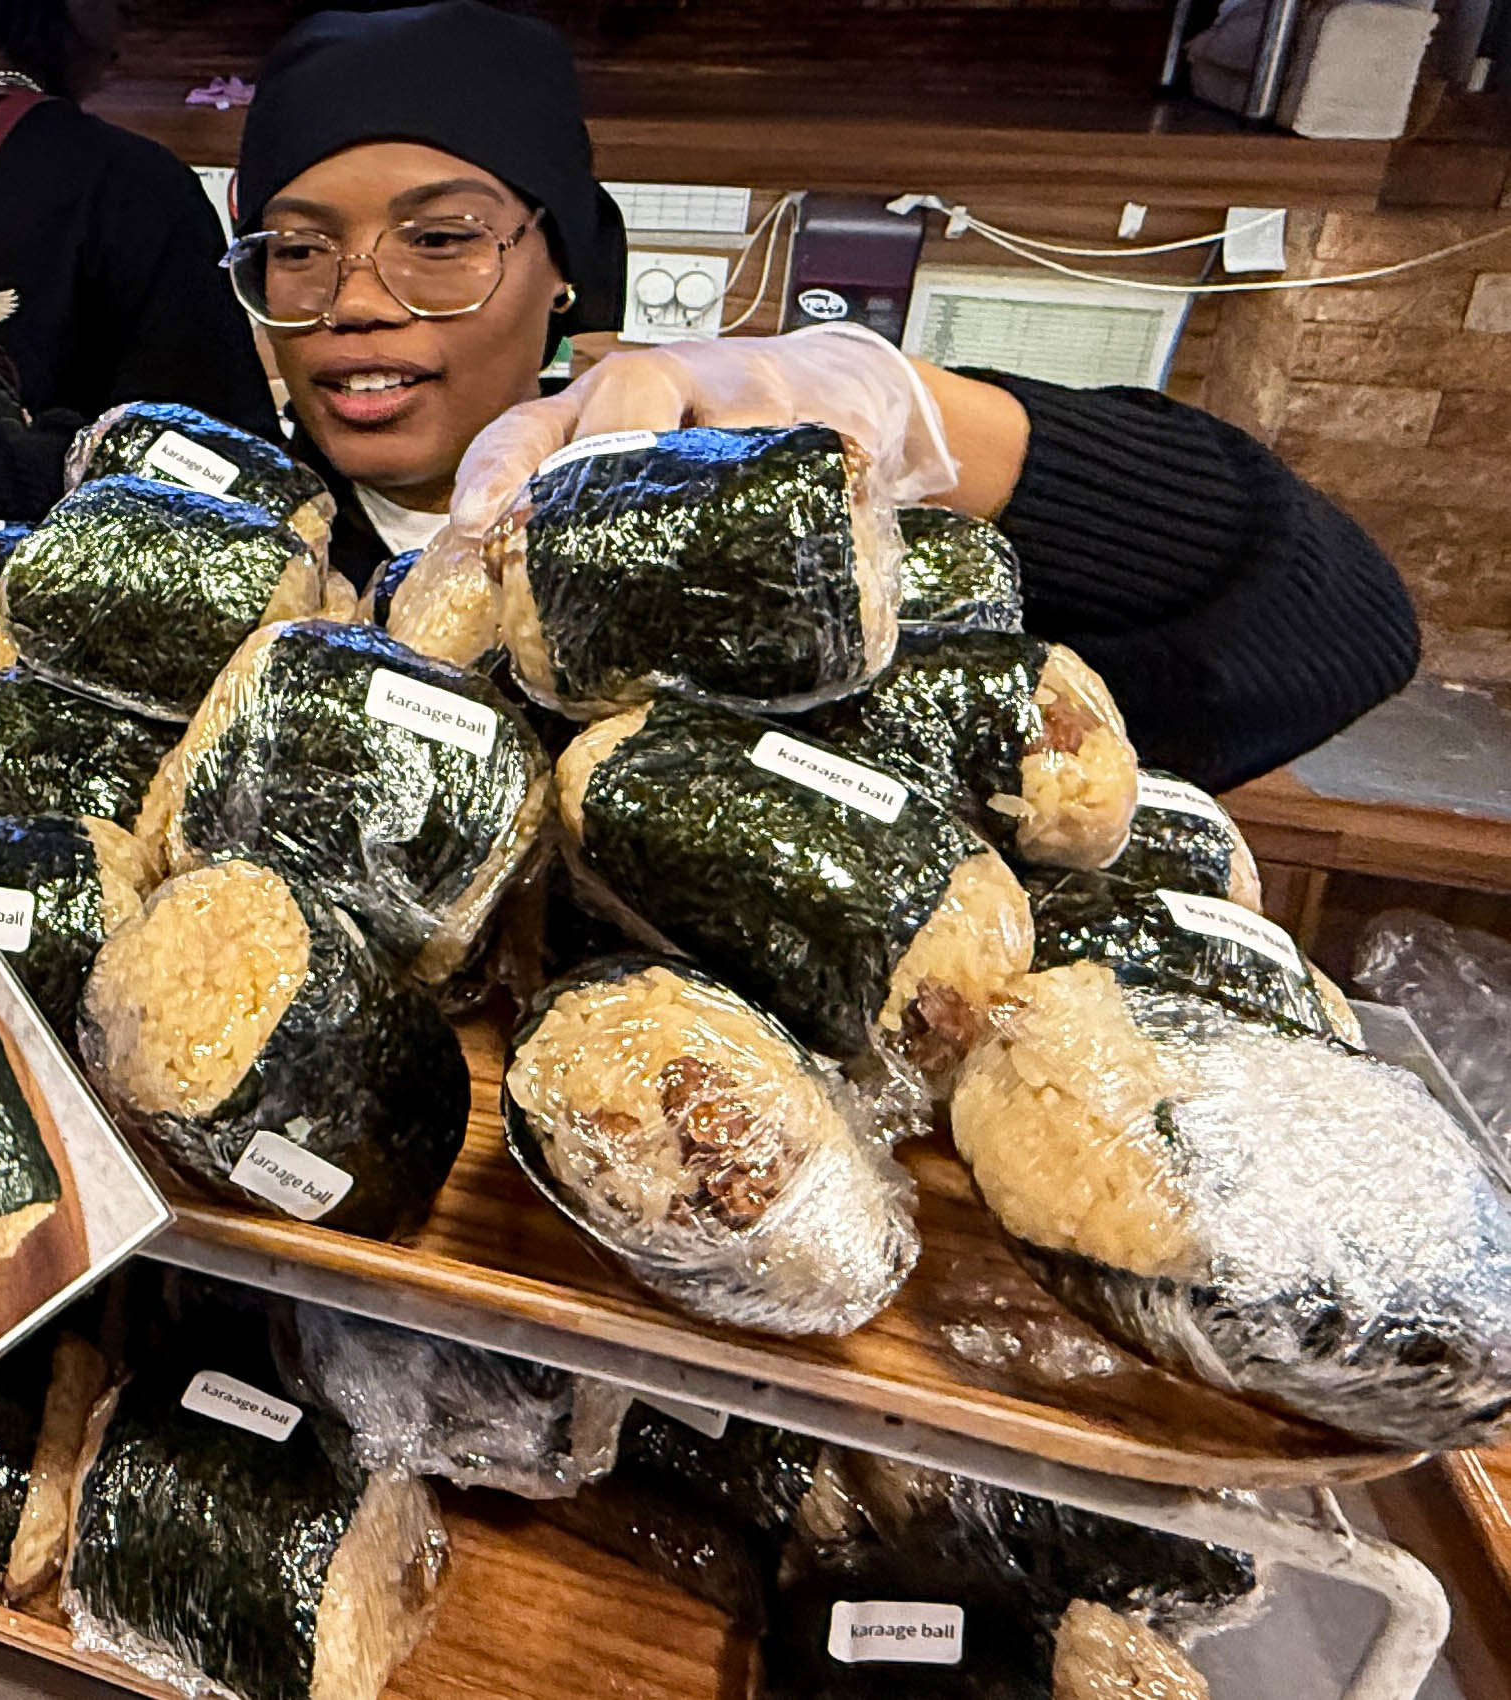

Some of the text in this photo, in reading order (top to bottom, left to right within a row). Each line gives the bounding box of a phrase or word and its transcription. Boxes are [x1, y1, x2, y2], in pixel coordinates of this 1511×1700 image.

[161, 444, 226, 485] karaage ball
[385, 689, 487, 737] karaage ball
[777, 748, 895, 806] karaage ball
[246, 1147, 335, 1206] karaage ball
[201, 1381, 290, 1426] karaage ball
[850, 1622, 956, 1641] karaage ball
